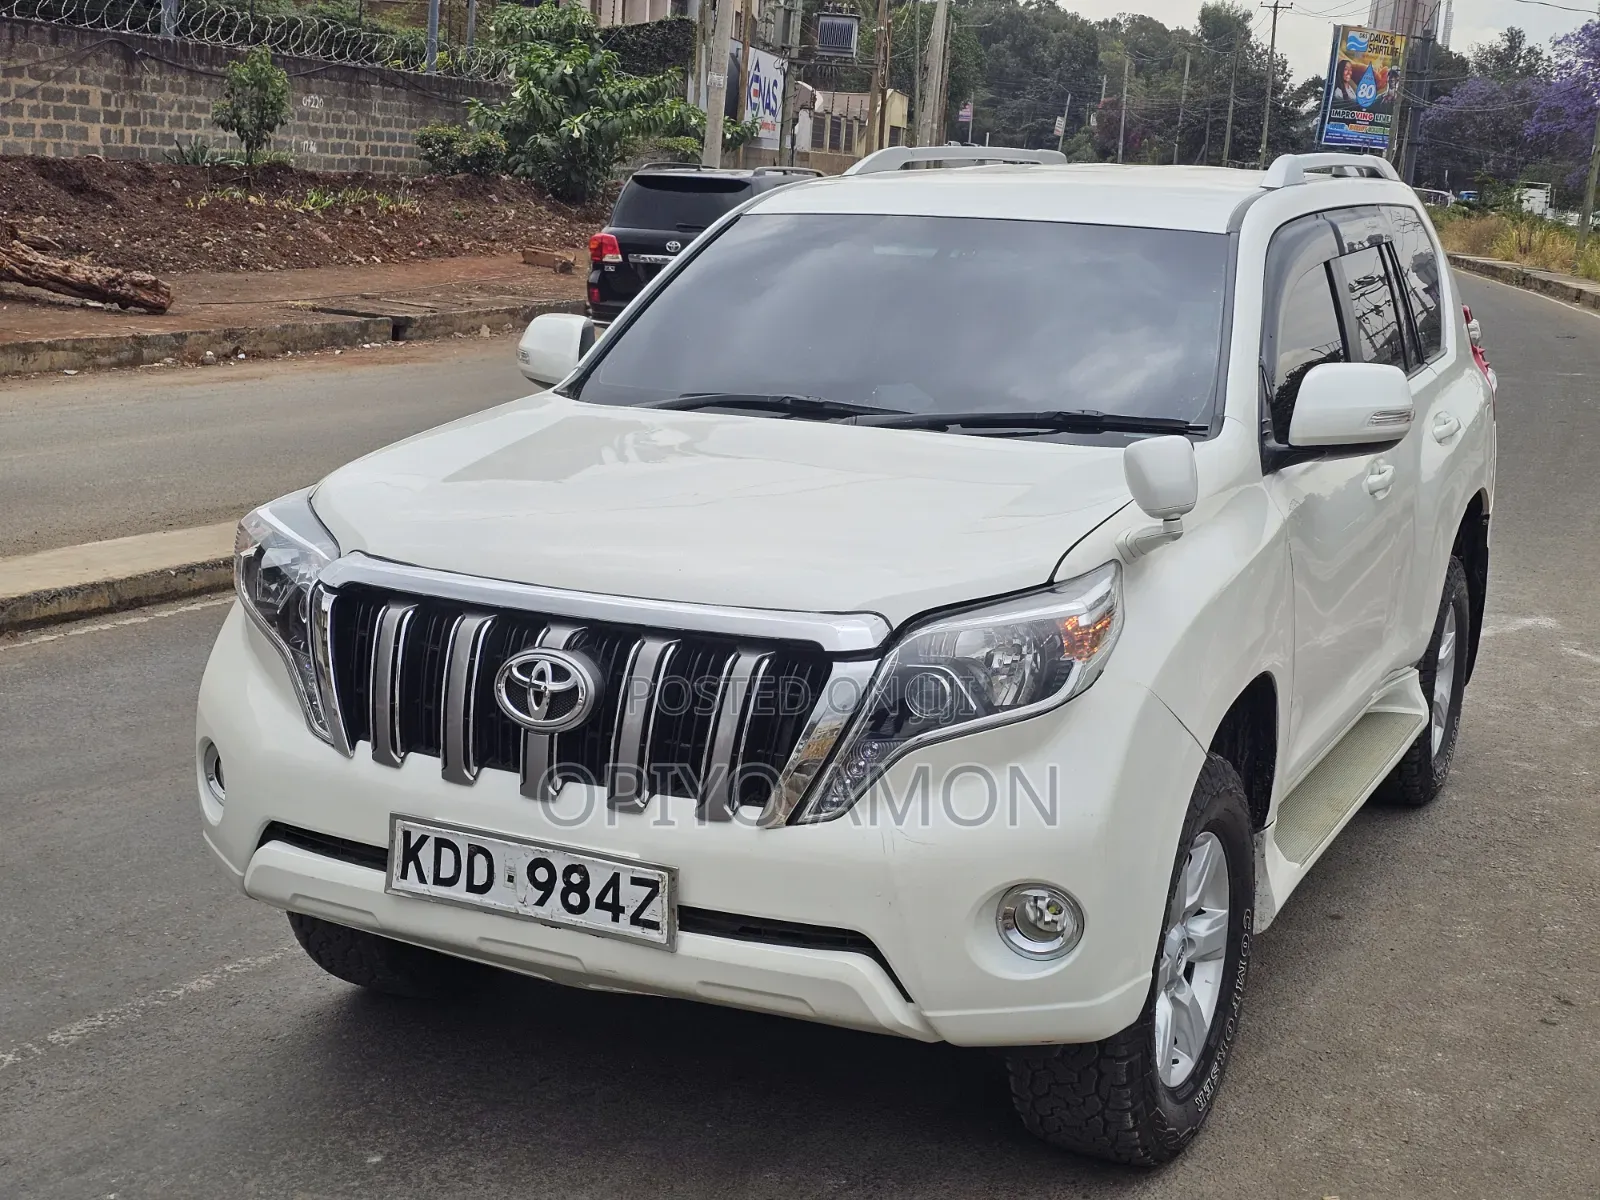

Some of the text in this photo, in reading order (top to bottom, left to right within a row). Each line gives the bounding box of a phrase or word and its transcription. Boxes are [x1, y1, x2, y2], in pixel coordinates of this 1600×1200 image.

[1369, 32, 1396, 46] DAVIS &
[1368, 43, 1399, 56] SHIRTLIFF
[1357, 83, 1375, 99] 80
[1331, 109, 1374, 121] IMPROVING
[1374, 113, 1392, 123] LIVE
[400, 830, 661, 931] KDD 984Z
[1194, 908, 1251, 1112] COMFORSER
